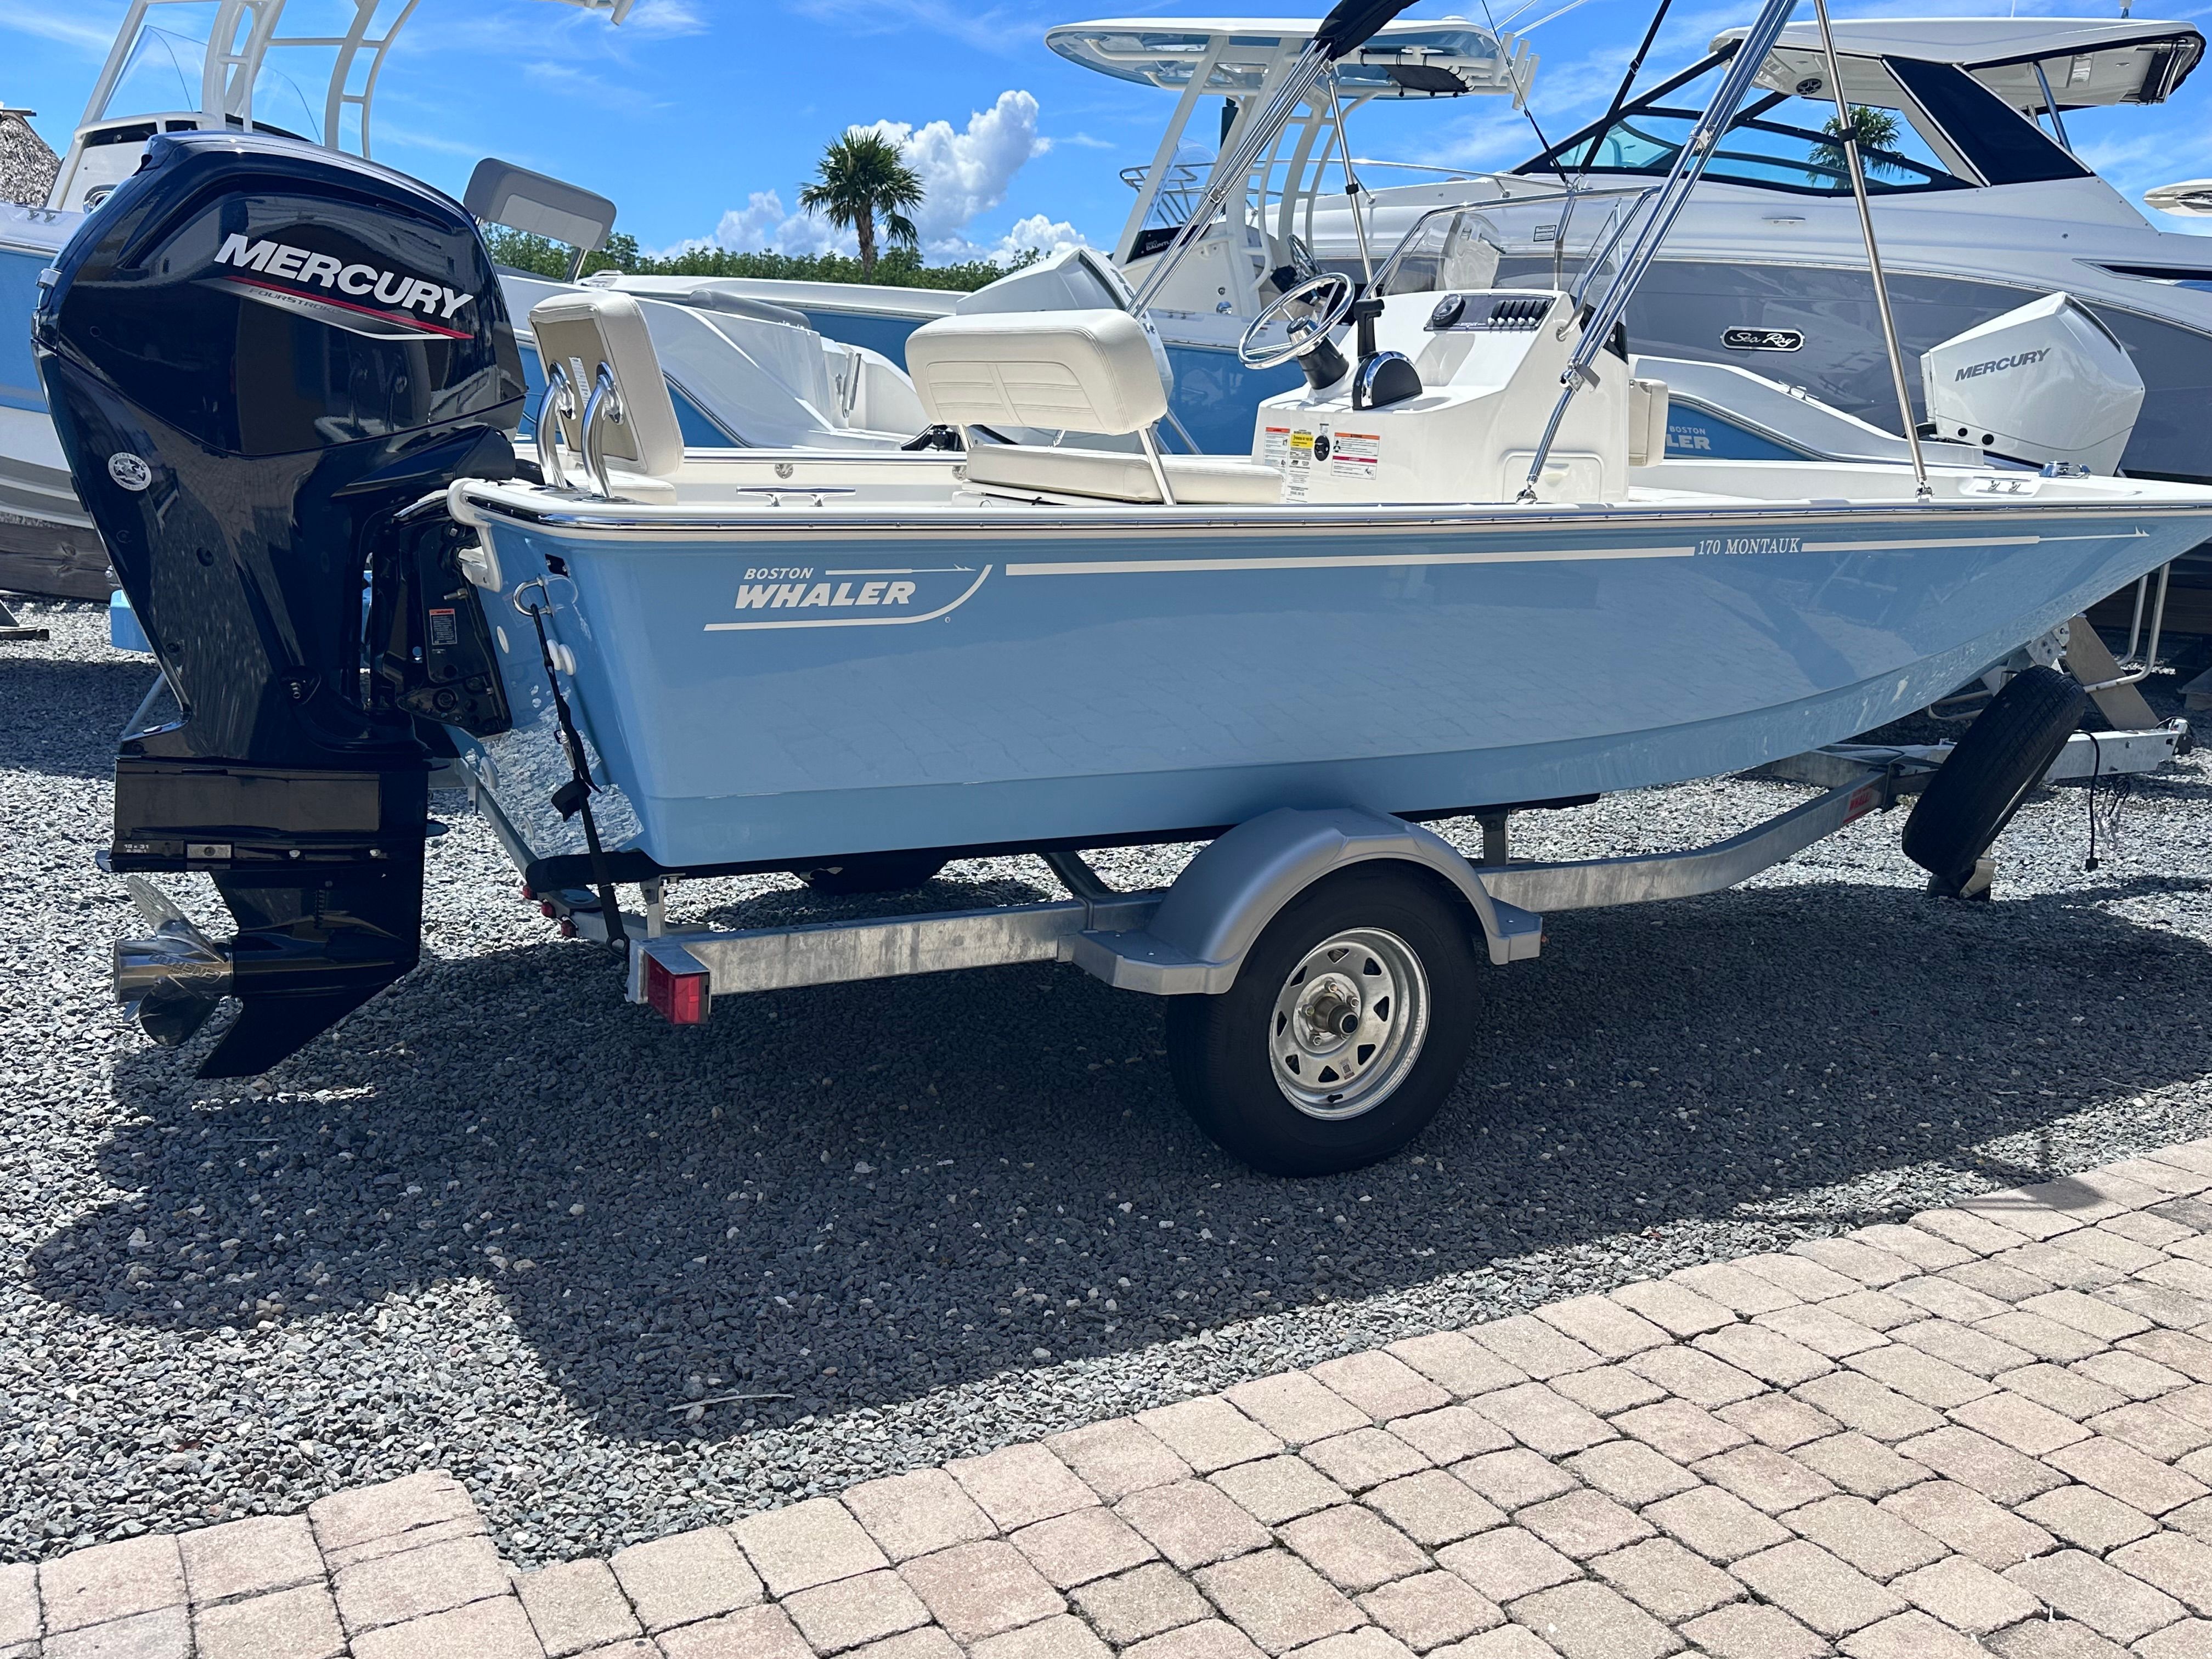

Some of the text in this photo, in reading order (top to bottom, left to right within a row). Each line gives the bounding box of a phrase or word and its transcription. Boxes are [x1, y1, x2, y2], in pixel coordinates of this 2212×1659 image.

[214, 233, 474, 319] MERCURY
[249, 287, 340, 314] FOURSTROKE
[1730, 332, 1796, 347] Sea Ray
[1955, 347, 2051, 382] MERCURY
[1669, 426, 1706, 435] BOSTON
[1666, 434, 1712, 450] LER
[1698, 538, 1801, 555] 170 MONTAUK
[743, 567, 814, 580] BOSTON
[735, 581, 916, 609] WHALER
